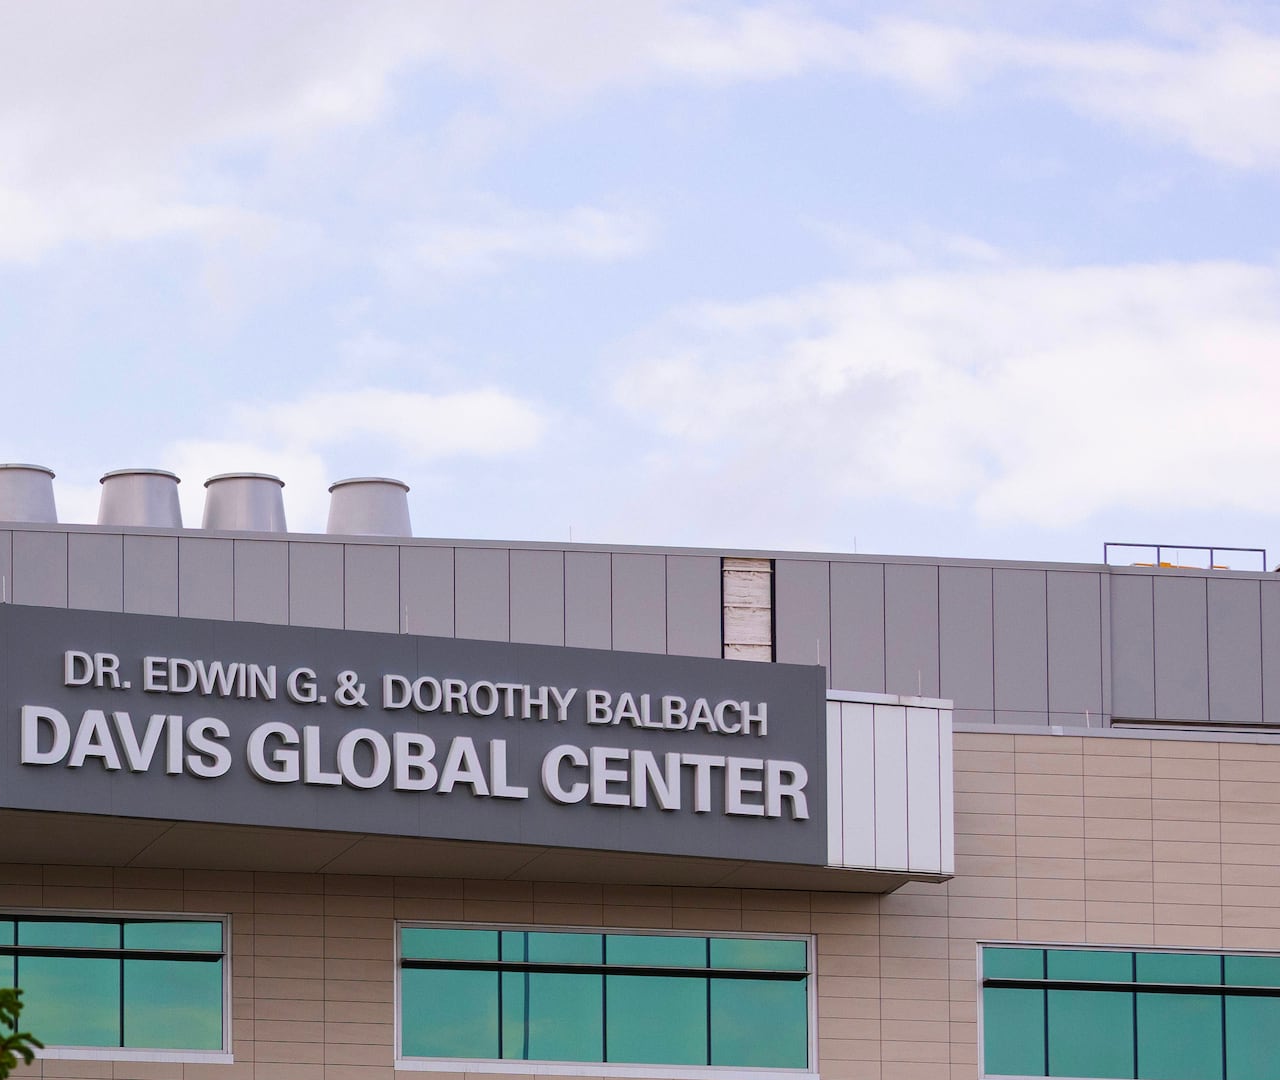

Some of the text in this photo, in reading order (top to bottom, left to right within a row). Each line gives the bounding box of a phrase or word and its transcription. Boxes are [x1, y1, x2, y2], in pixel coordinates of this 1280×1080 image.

[64, 650, 768, 736] DR. EDWIN G. & DOROTHY BALBACH
[21, 704, 810, 820] DAVIS GLOBAL CENTER
